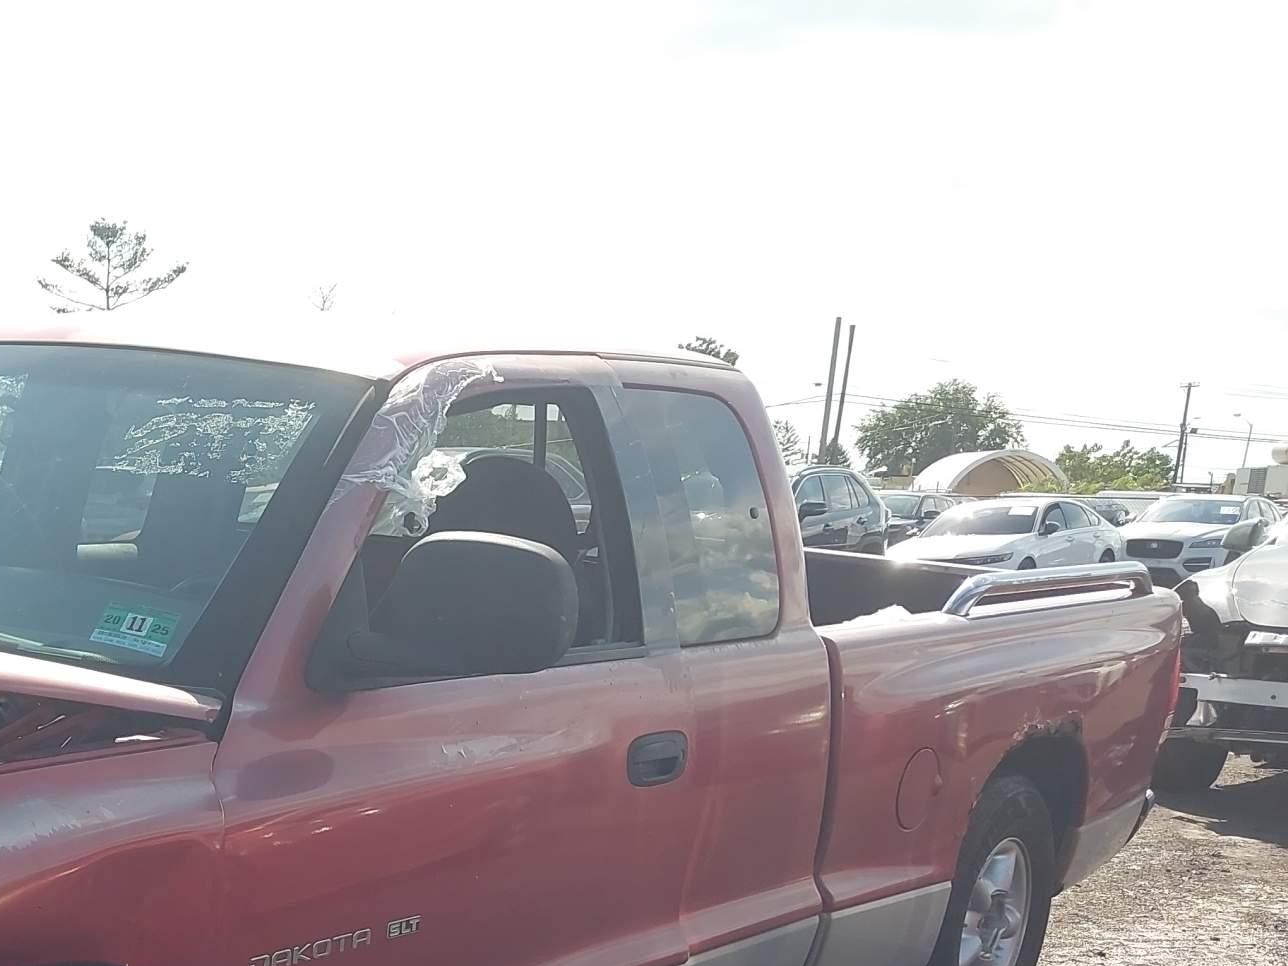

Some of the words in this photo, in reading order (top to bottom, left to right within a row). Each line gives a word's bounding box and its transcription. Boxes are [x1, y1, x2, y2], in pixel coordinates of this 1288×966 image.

[103, 614, 121, 625] 20
[125, 615, 147, 633] 11
[151, 623, 169, 636] 25
[387, 915, 421, 939] SLT
